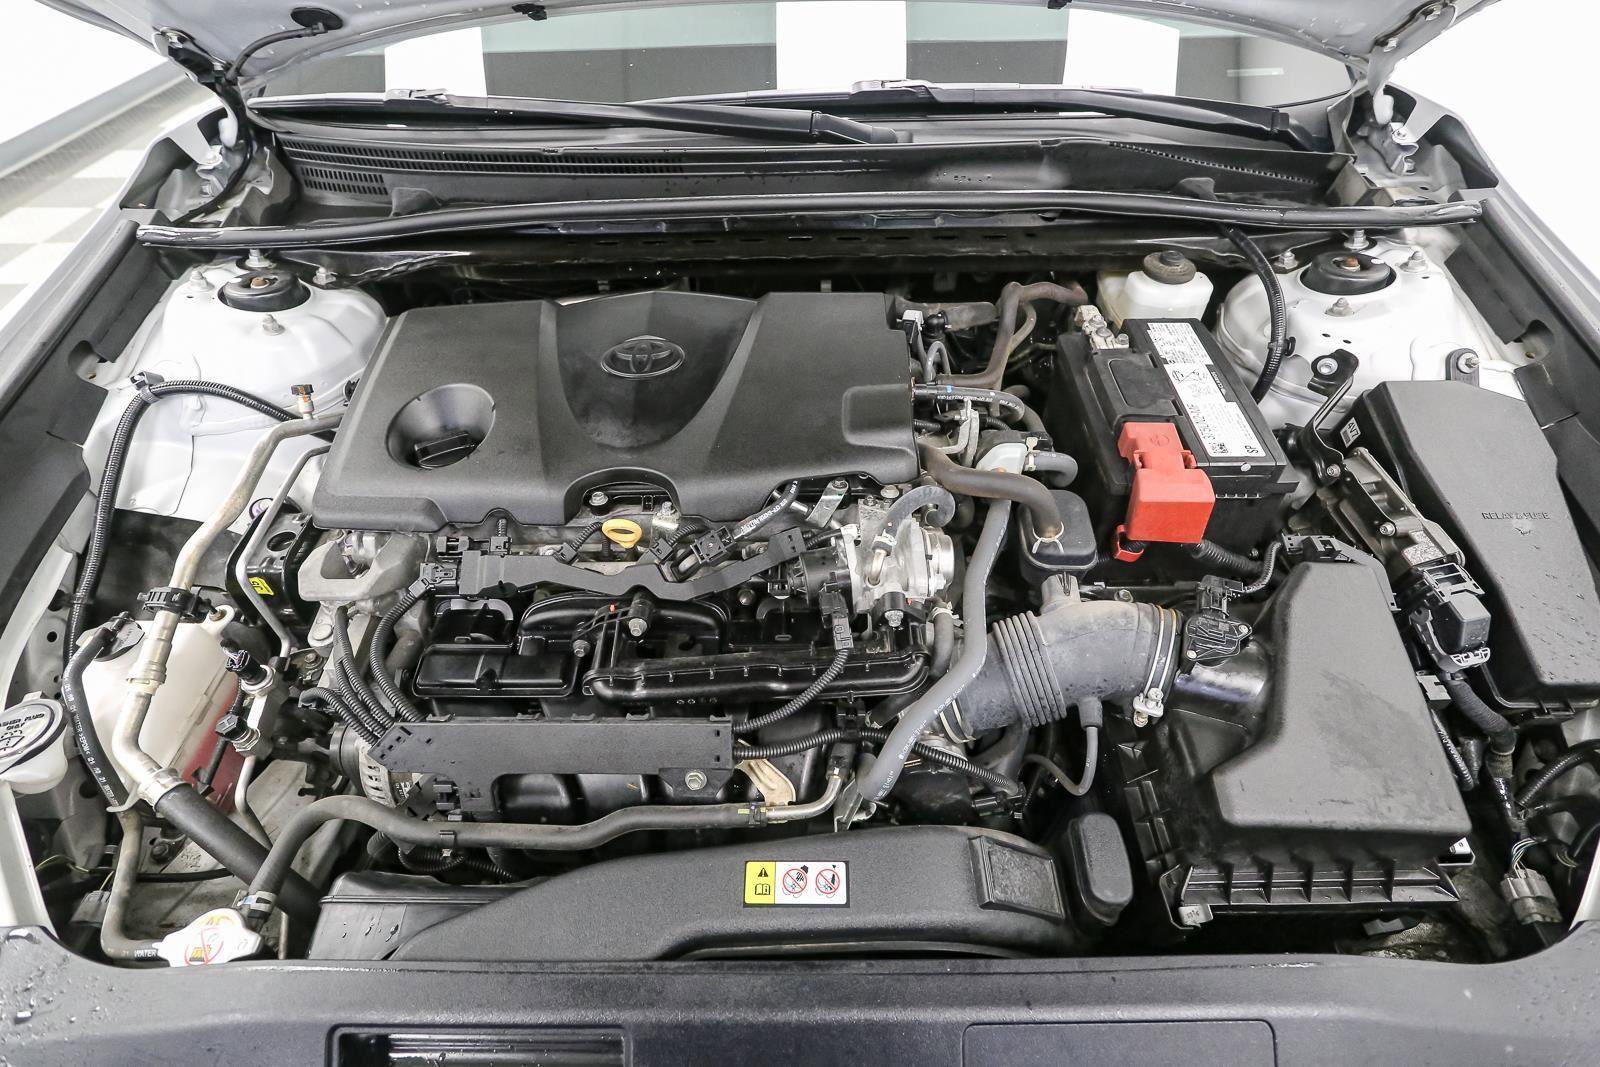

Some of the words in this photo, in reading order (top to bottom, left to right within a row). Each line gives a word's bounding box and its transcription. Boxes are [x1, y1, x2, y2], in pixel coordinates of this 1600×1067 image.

[1245, 445, 1259, 454] SP
[1481, 512, 1513, 520] RELAY
[1522, 512, 1551, 520] FUSE
[24, 713, 45, 722] FLUID
[73, 714, 83, 735] WATER
[134, 949, 157, 958] WATER
